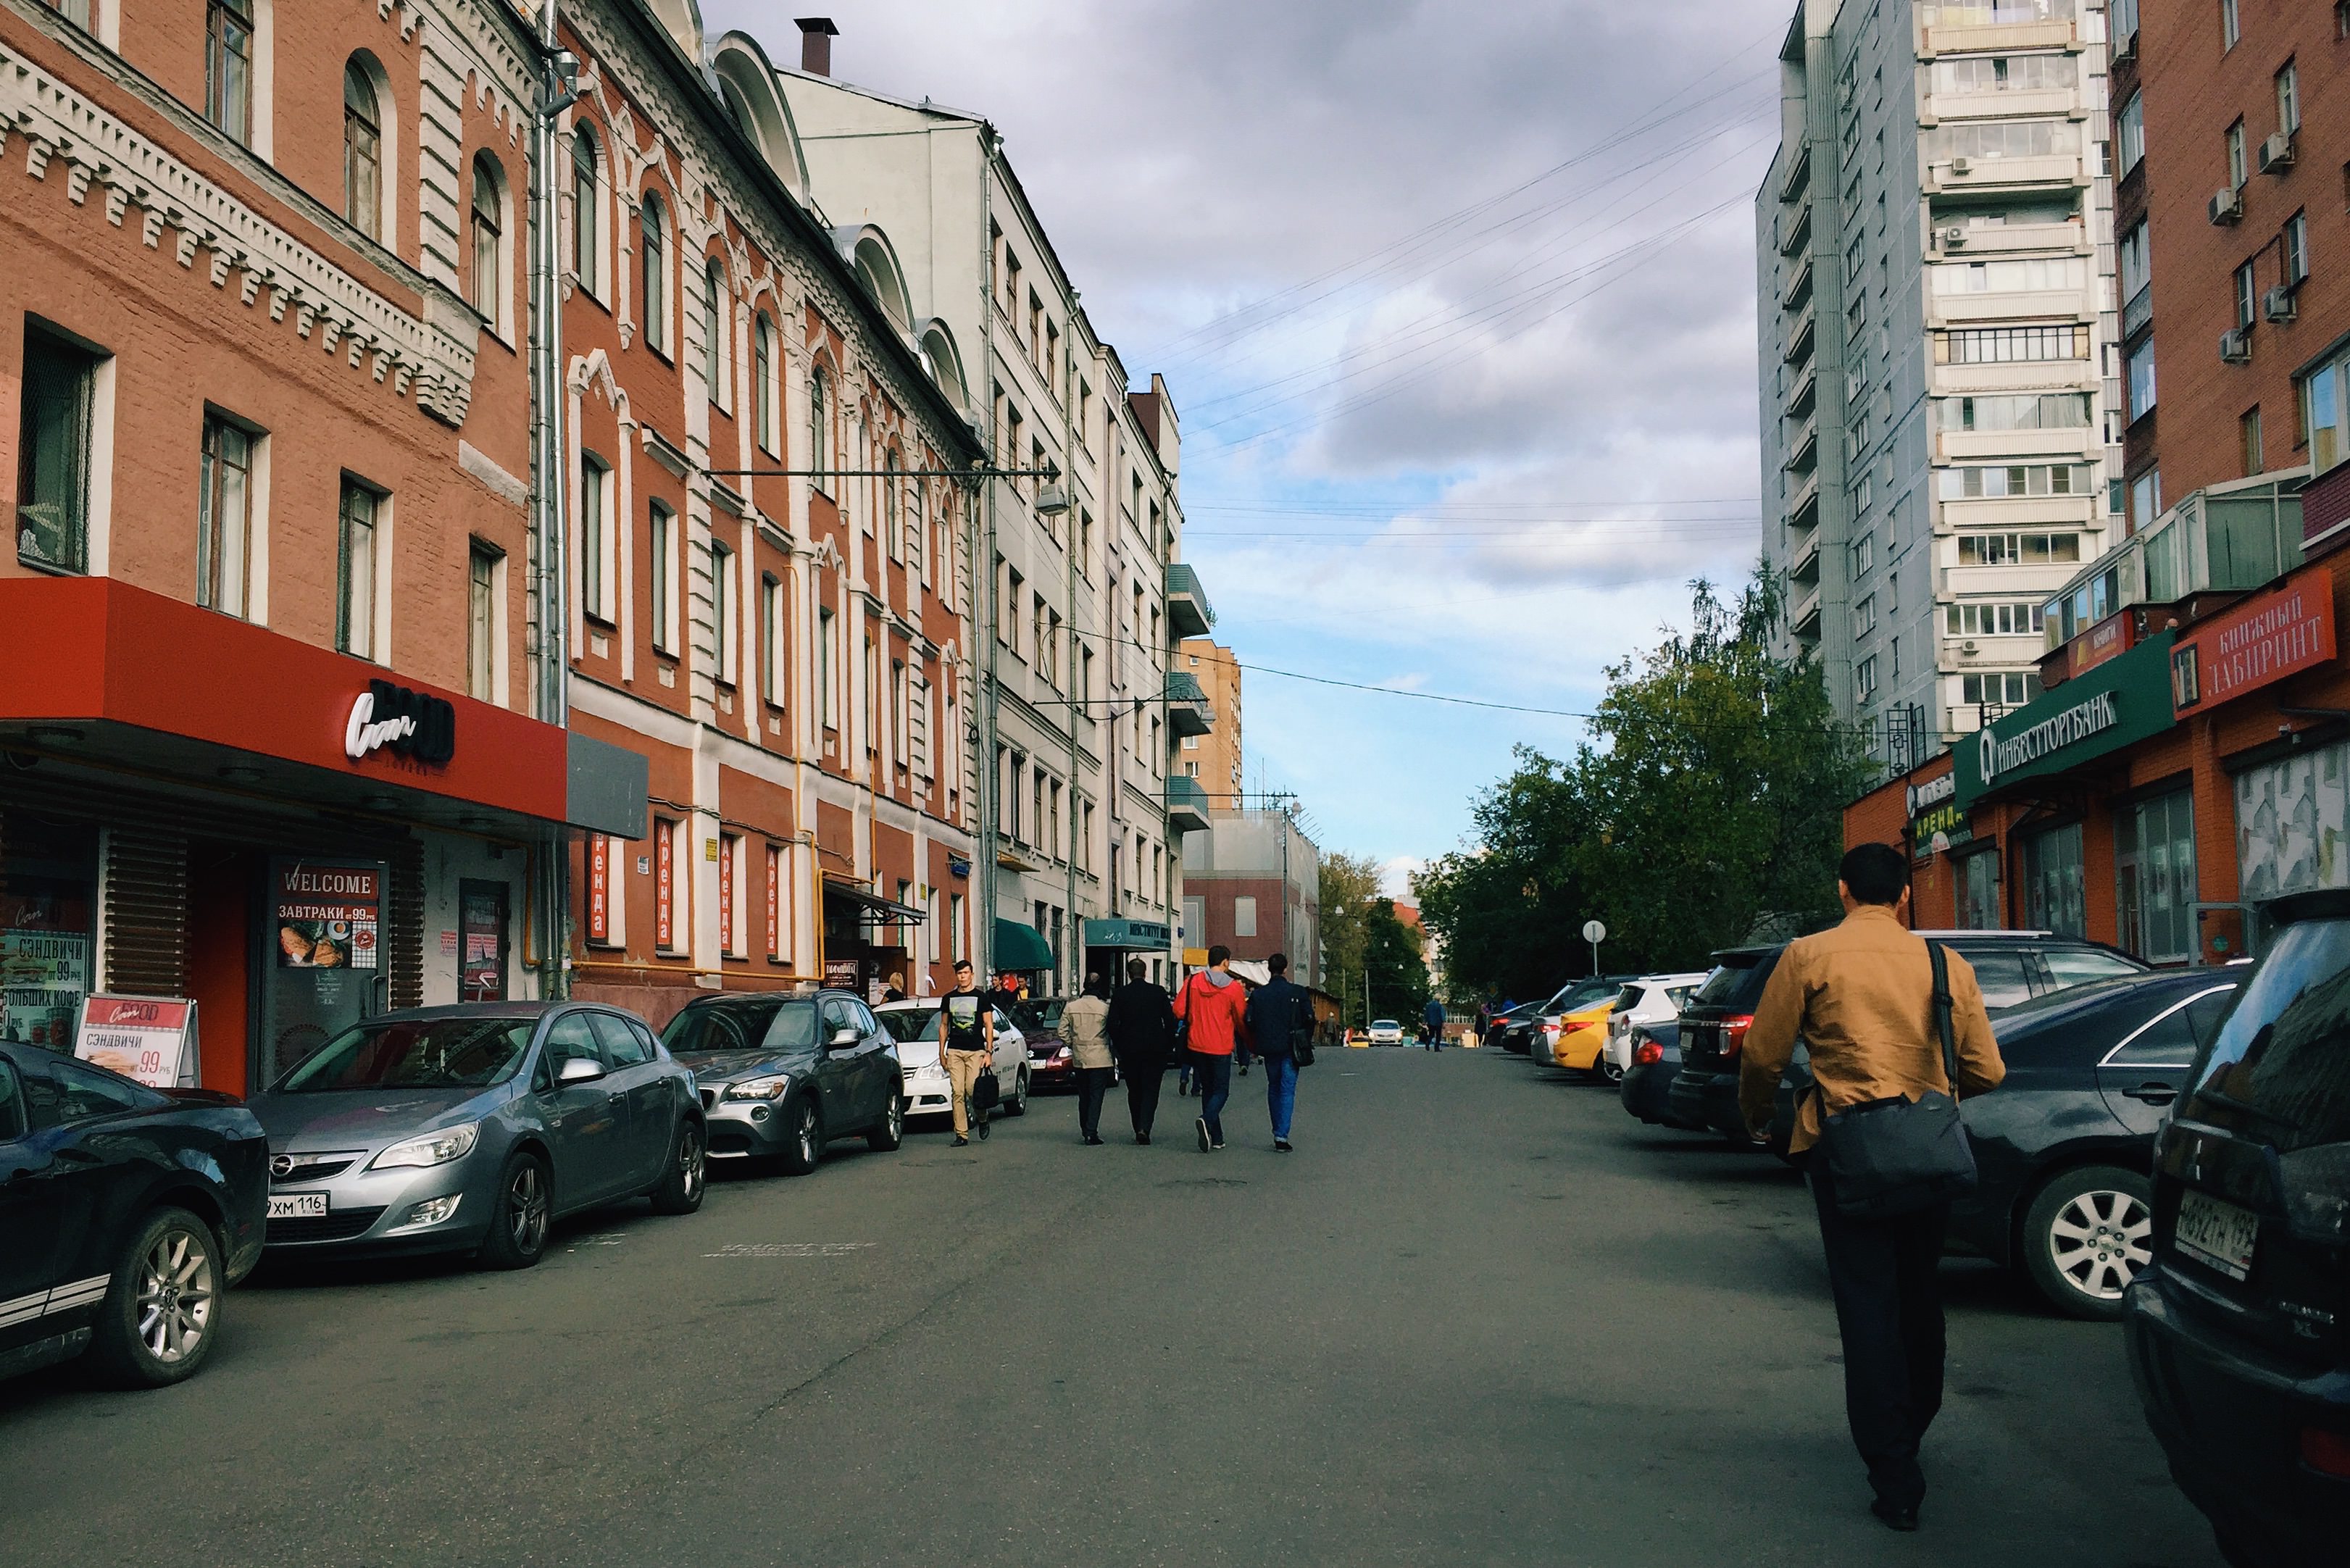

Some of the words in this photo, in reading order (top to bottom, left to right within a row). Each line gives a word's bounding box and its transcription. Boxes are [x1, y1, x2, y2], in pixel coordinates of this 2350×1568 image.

[2220, 591, 2302, 655] КНИЖНЫЙ
[2093, 623, 2117, 650] КНИГИ
[2208, 616, 2322, 696] ЛАБИРИНТ
[346, 692, 417, 758] Can
[1997, 691, 2116, 775] ИНВЕСТТОРГБАНК
[284, 872, 371, 894] WELCOME
[593, 835, 604, 932] ренда
[660, 825, 670, 938] Аренда
[721, 839, 730, 944] Аренда
[278, 905, 344, 920] ЗАВТРАКИ
[352, 908, 366, 920] 99
[19, 938, 83, 961] СЭНДВИЧИ
[57, 961, 70, 982] 99
[54, 990, 80, 1006] КОФЕ
[86, 1033, 143, 1048] СЭНДВИЧИ
[140, 1051, 160, 1074] 99
[298, 1196, 321, 1209] 116
